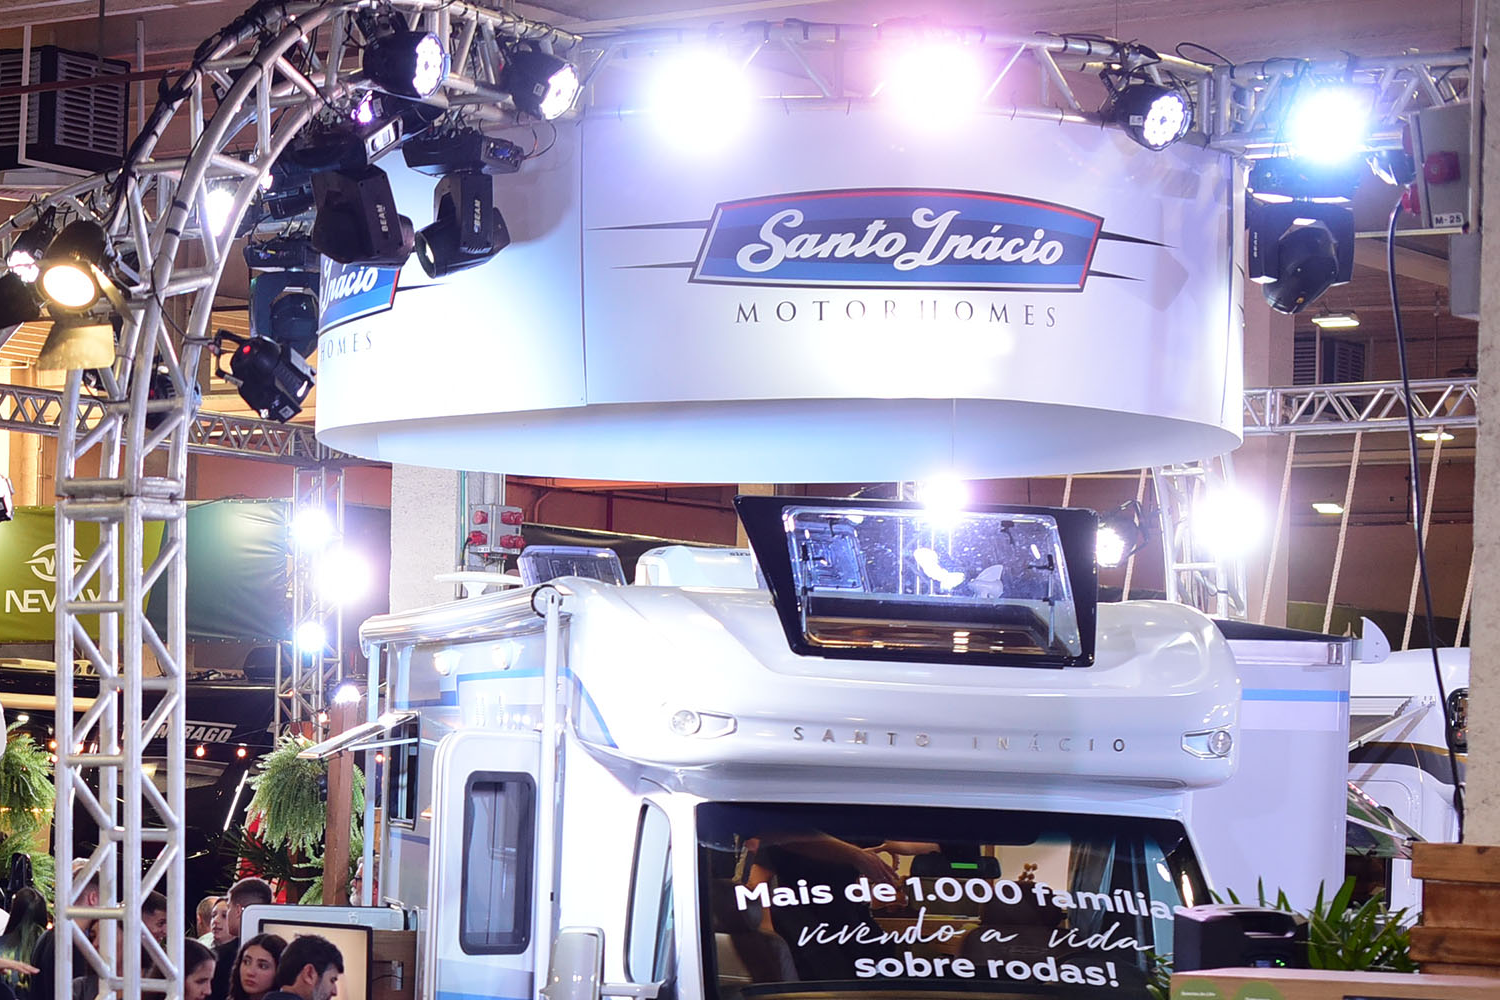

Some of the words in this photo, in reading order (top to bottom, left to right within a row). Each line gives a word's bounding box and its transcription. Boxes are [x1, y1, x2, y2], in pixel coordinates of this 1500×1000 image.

[376, 204, 389, 232] BEAM
[735, 209, 907, 273] Santo
[893, 207, 1064, 271] Inácio
[735, 300, 1057, 328] MOTORHOMES
[793, 726, 931, 748] SANTO
[734, 879, 834, 911] Mais
[844, 876, 897, 902] de
[905, 876, 1023, 905] 1.000
[1031, 881, 1181, 921] família
[797, 906, 966, 947] vivendo
[979, 926, 1019, 943] a
[1047, 921, 1155, 951] vida
[854, 951, 976, 978] sobre
[987, 956, 1120, 988] rodas!
